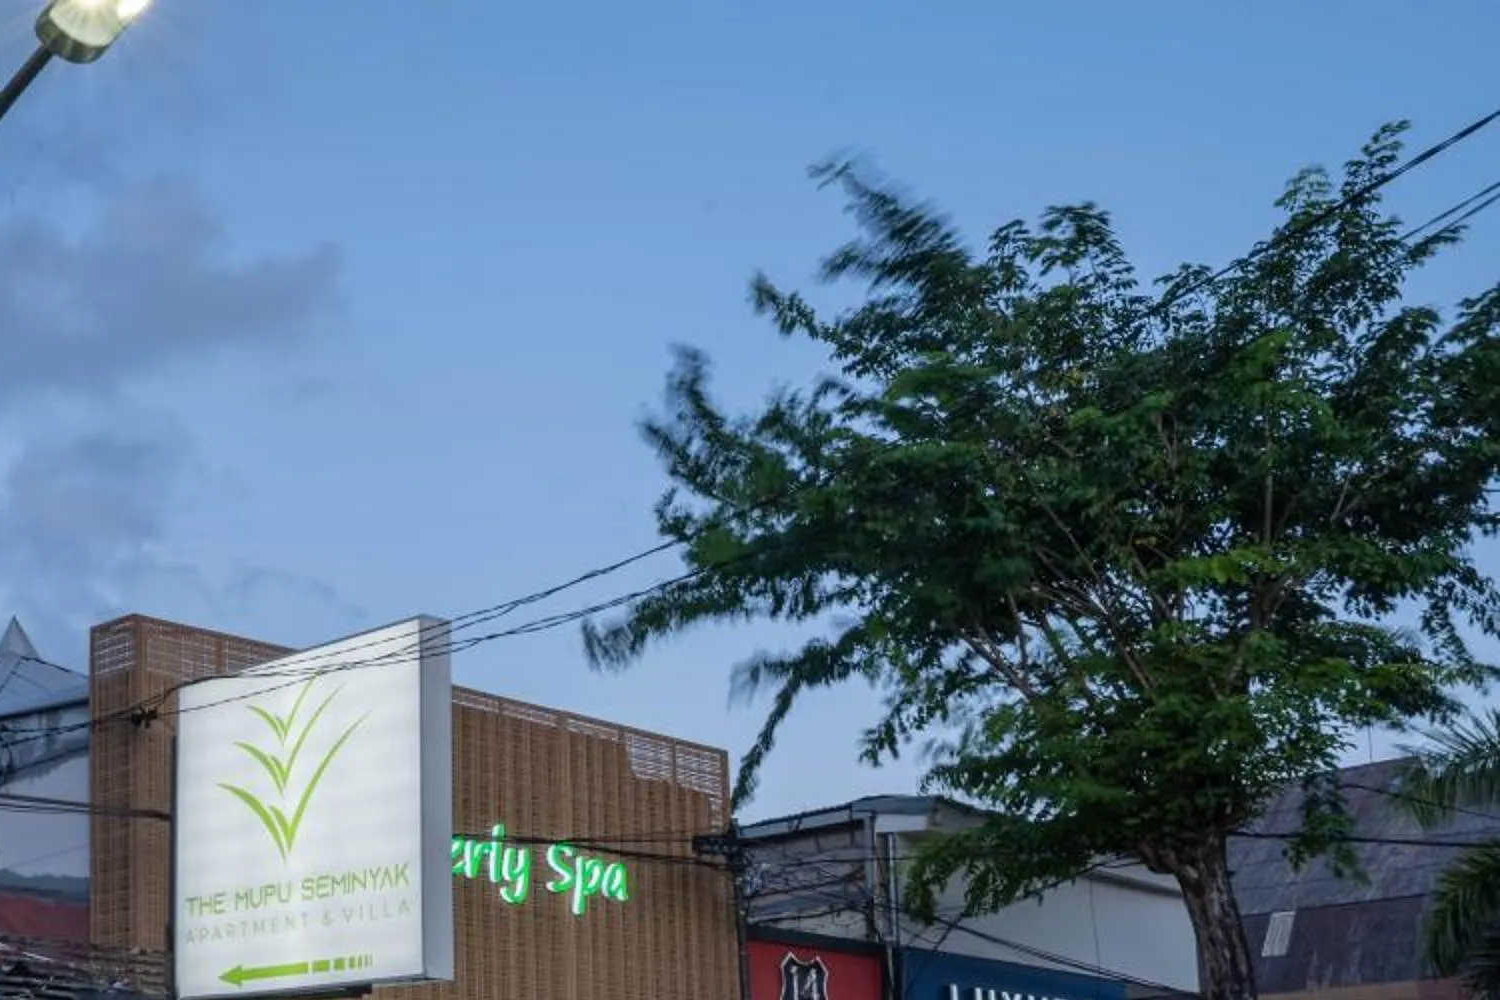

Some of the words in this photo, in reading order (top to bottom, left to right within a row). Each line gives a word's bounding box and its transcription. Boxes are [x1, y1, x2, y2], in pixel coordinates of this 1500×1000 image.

[185, 892, 227, 918] THE
[235, 882, 292, 911] MUPU
[301, 862, 411, 900] SEMINYAK
[546, 841, 628, 916] Spa
[186, 914, 309, 944] APARTMENT
[323, 912, 334, 926] &
[342, 898, 411, 925] VILLA
